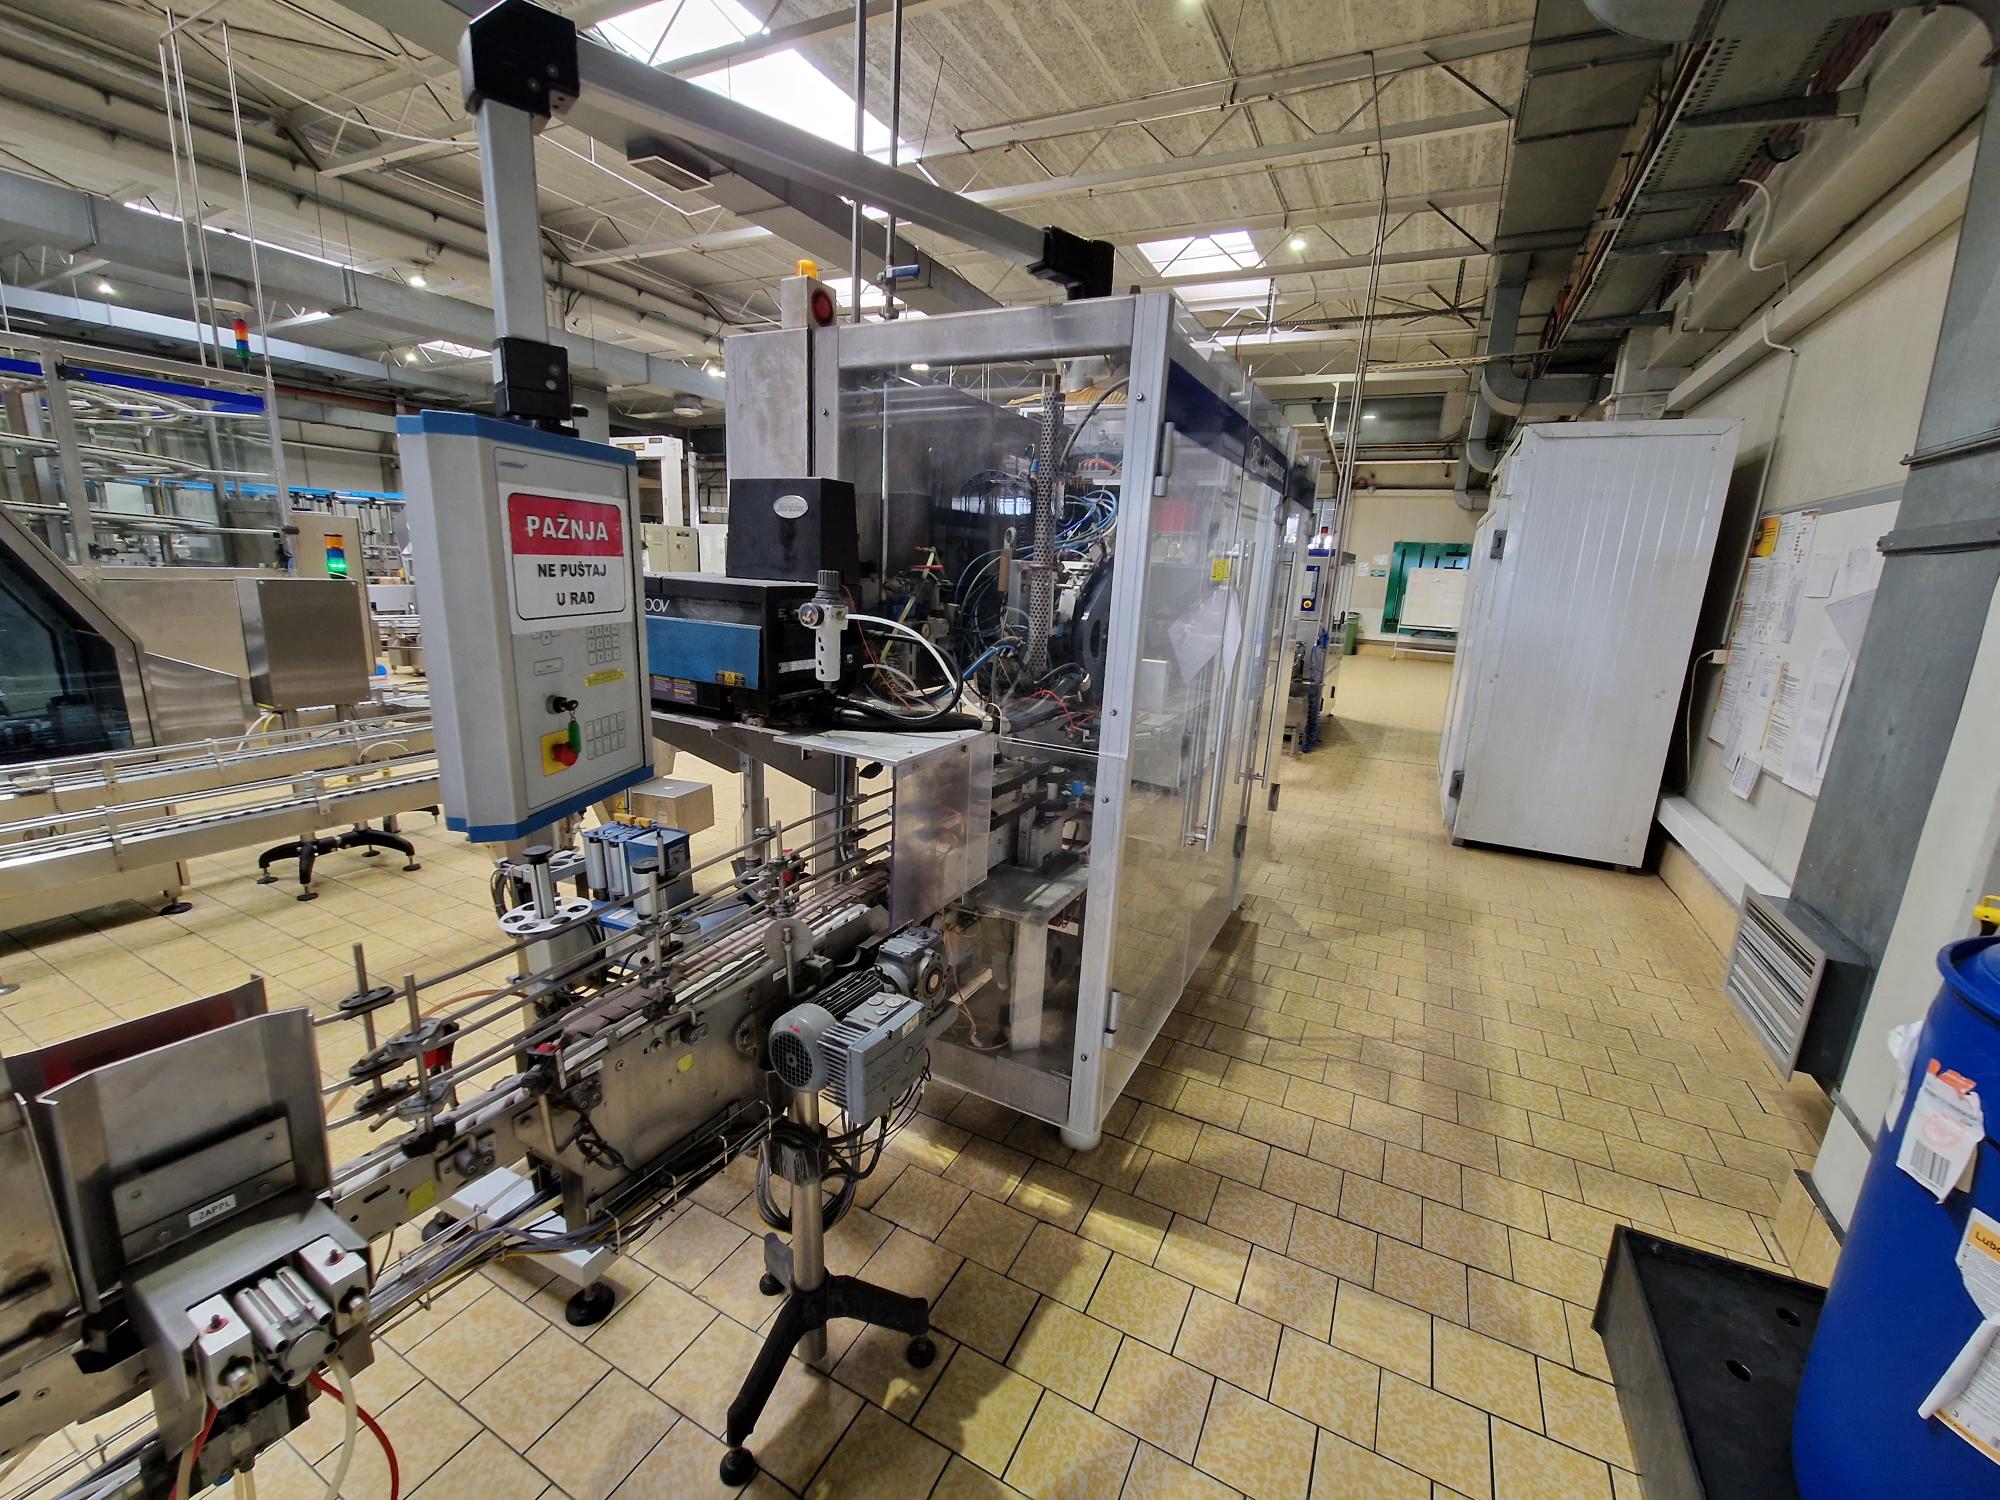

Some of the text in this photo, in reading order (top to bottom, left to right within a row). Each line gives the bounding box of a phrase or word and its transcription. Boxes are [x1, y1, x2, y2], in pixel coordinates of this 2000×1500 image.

[526, 512, 609, 541] PAŽNJA
[537, 561, 607, 577] NE PUŠTAJ
[556, 591, 595, 606] U RAD
